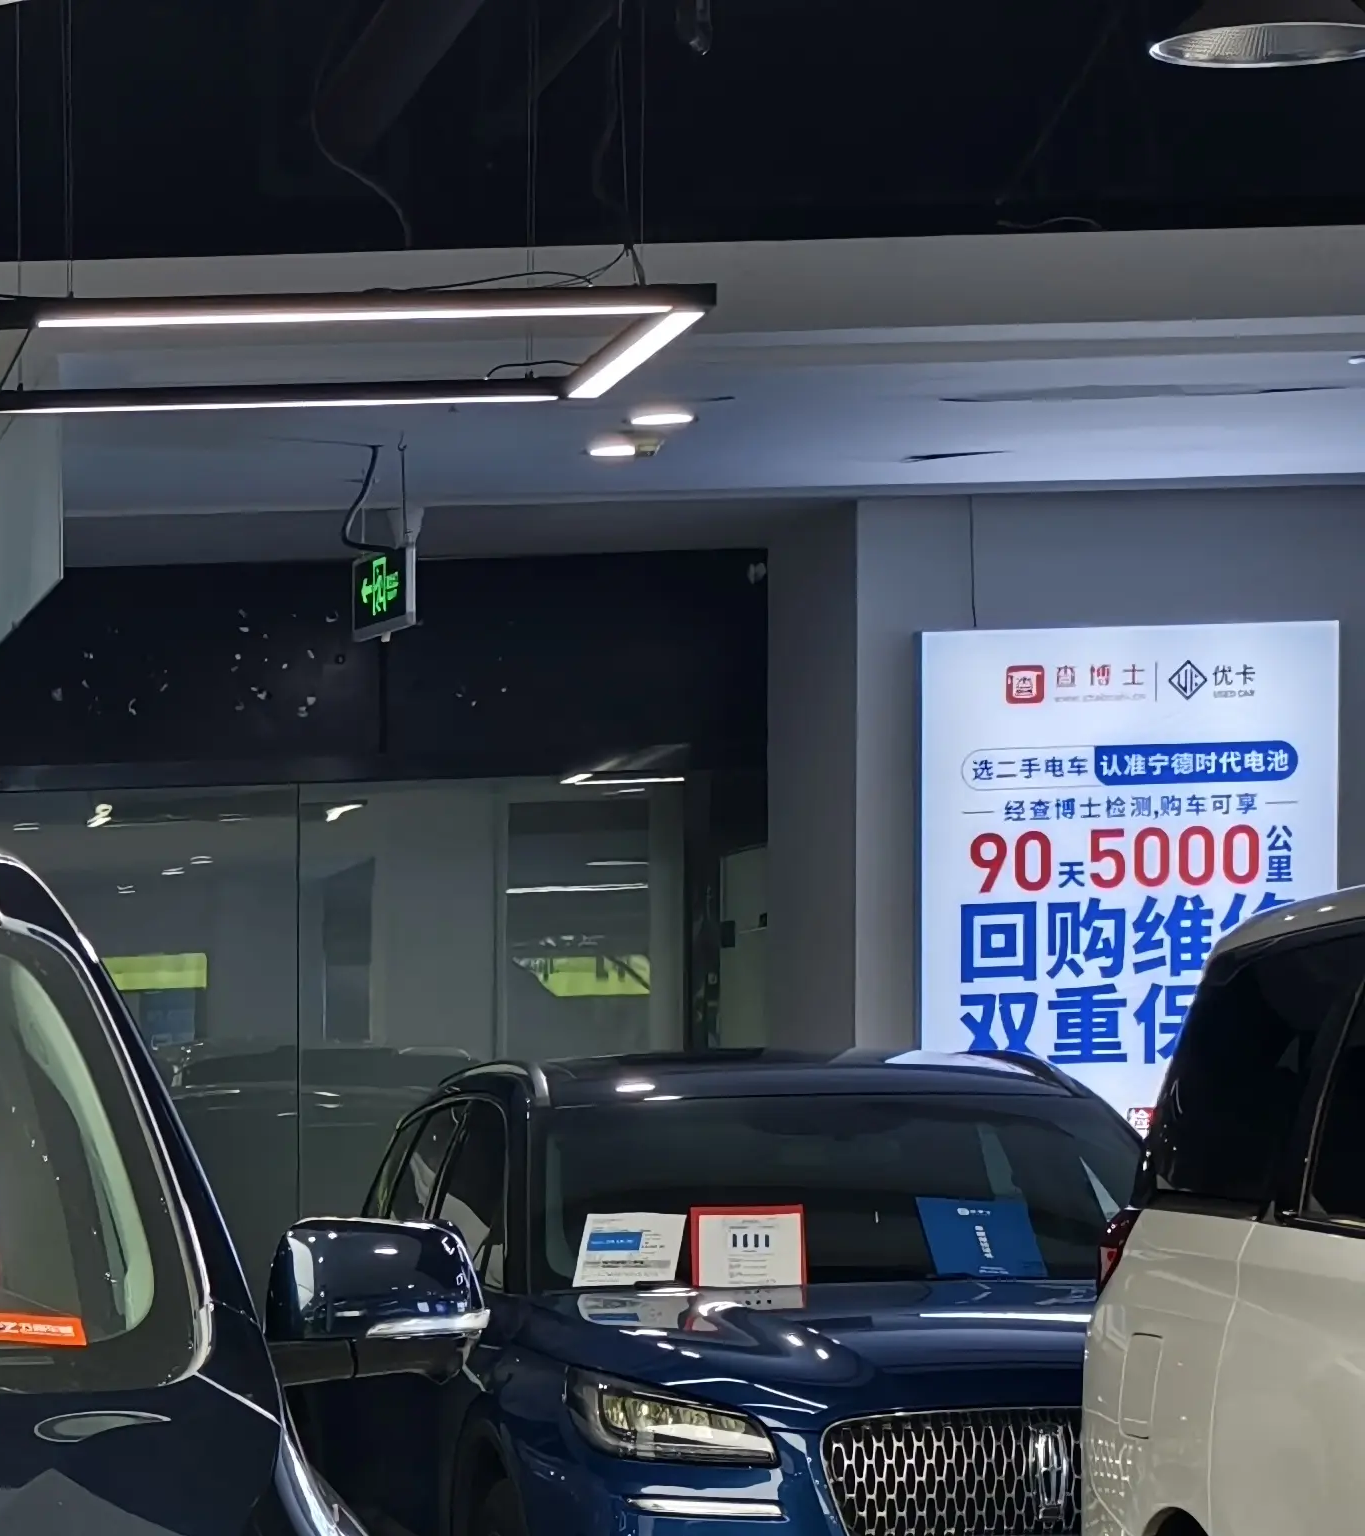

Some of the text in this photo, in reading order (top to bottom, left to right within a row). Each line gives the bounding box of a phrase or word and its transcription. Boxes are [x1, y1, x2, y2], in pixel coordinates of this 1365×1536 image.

[1212, 663, 1257, 687] 优卡
[971, 749, 1290, 782] 选二手电车 认准宁德时代电池
